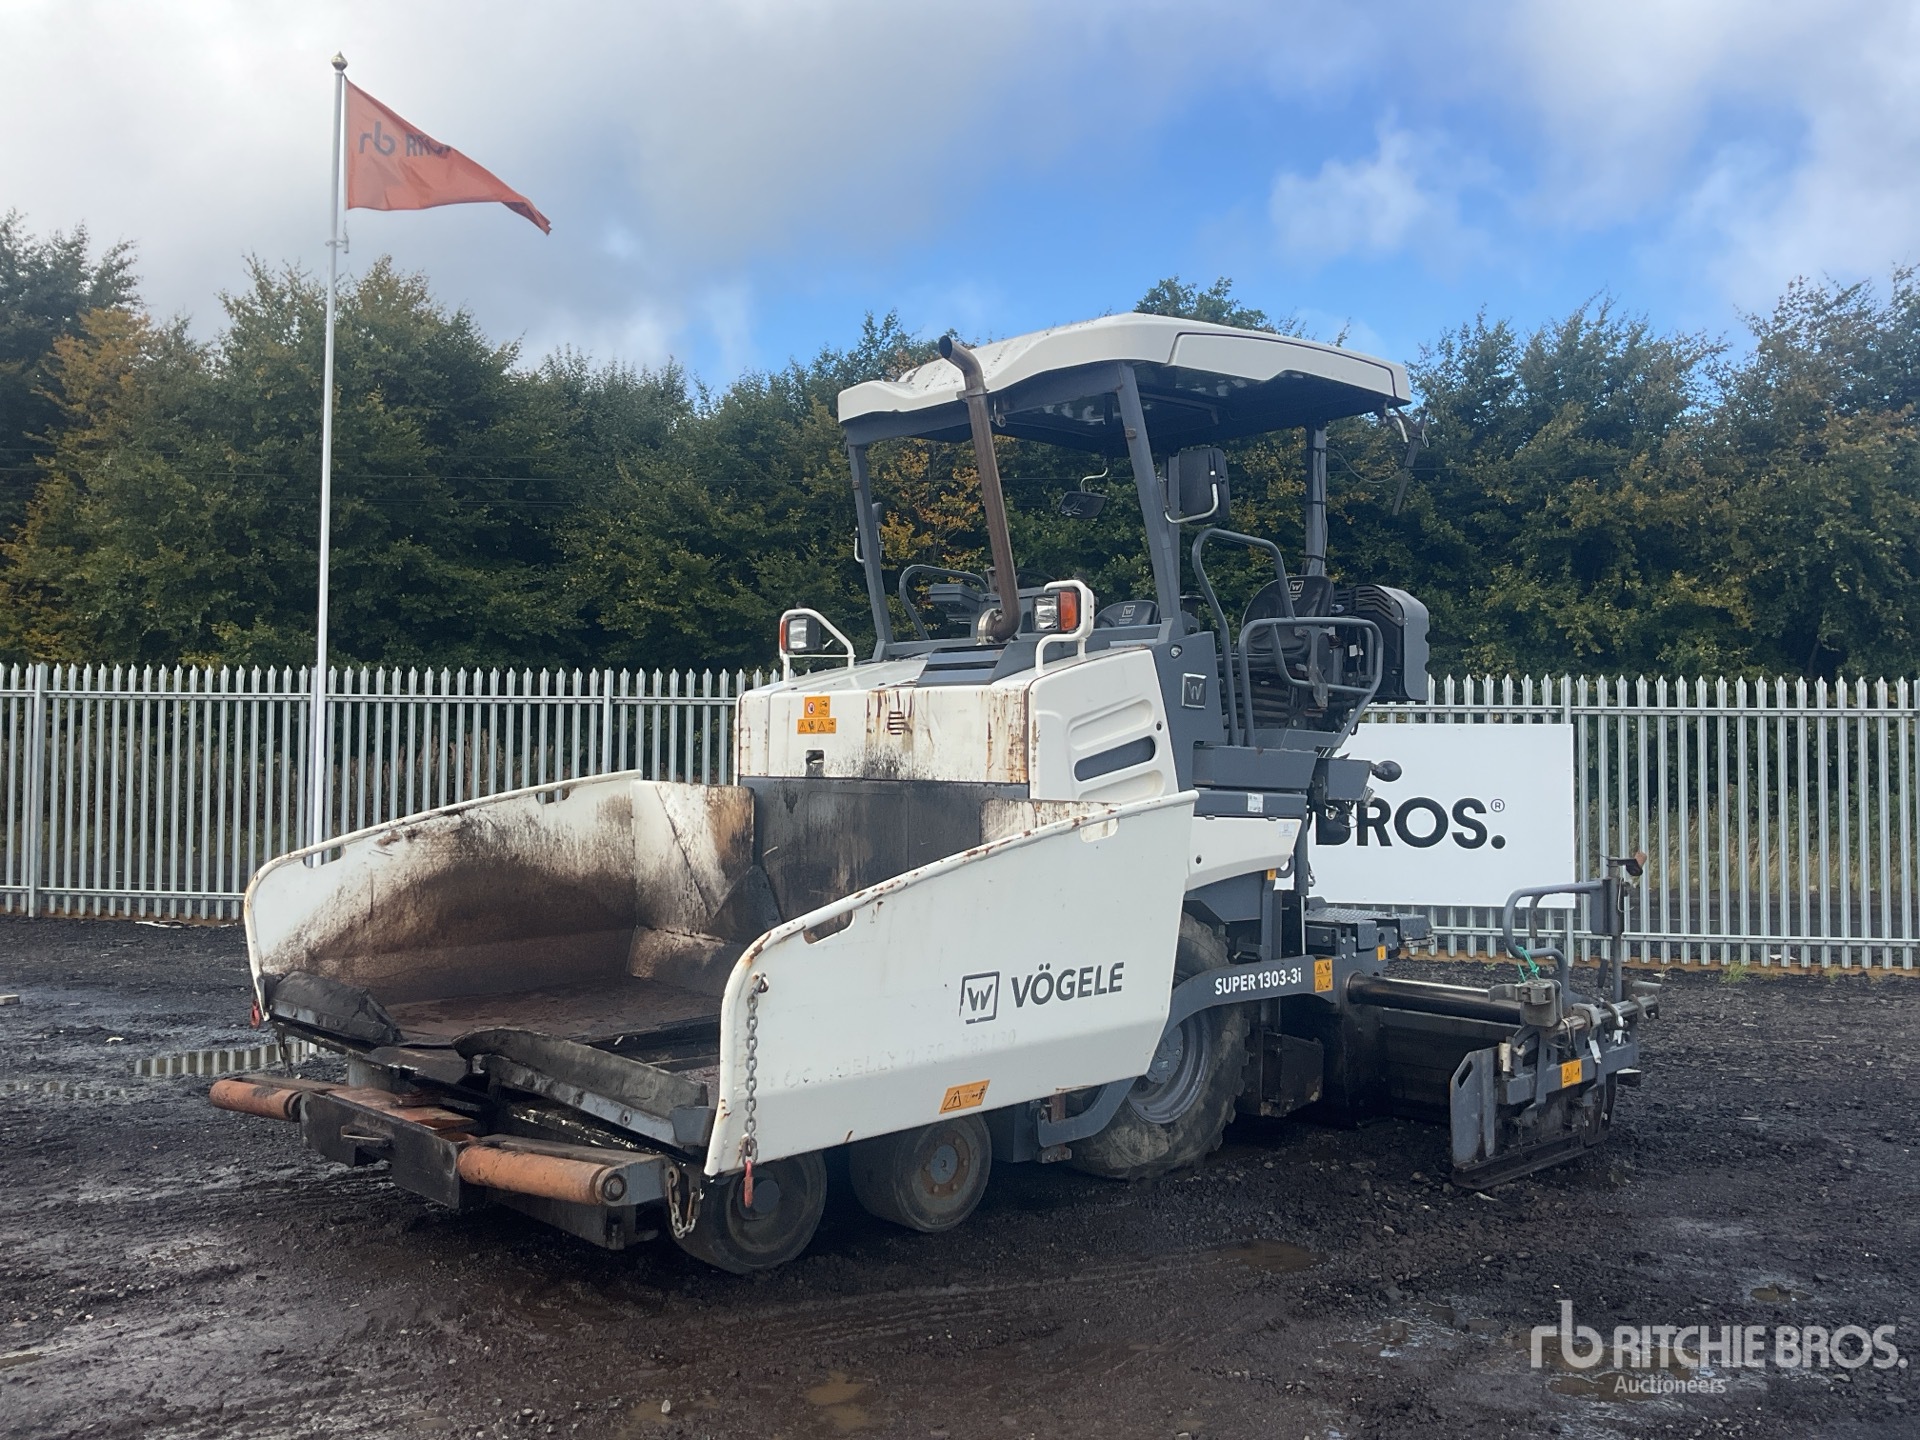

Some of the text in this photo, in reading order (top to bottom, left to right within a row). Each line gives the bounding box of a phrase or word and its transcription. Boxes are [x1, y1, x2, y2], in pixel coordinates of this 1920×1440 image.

[1011, 962, 1124, 1008] VÖGELE
[1215, 967, 1302, 995] SUPER 1303-3i
